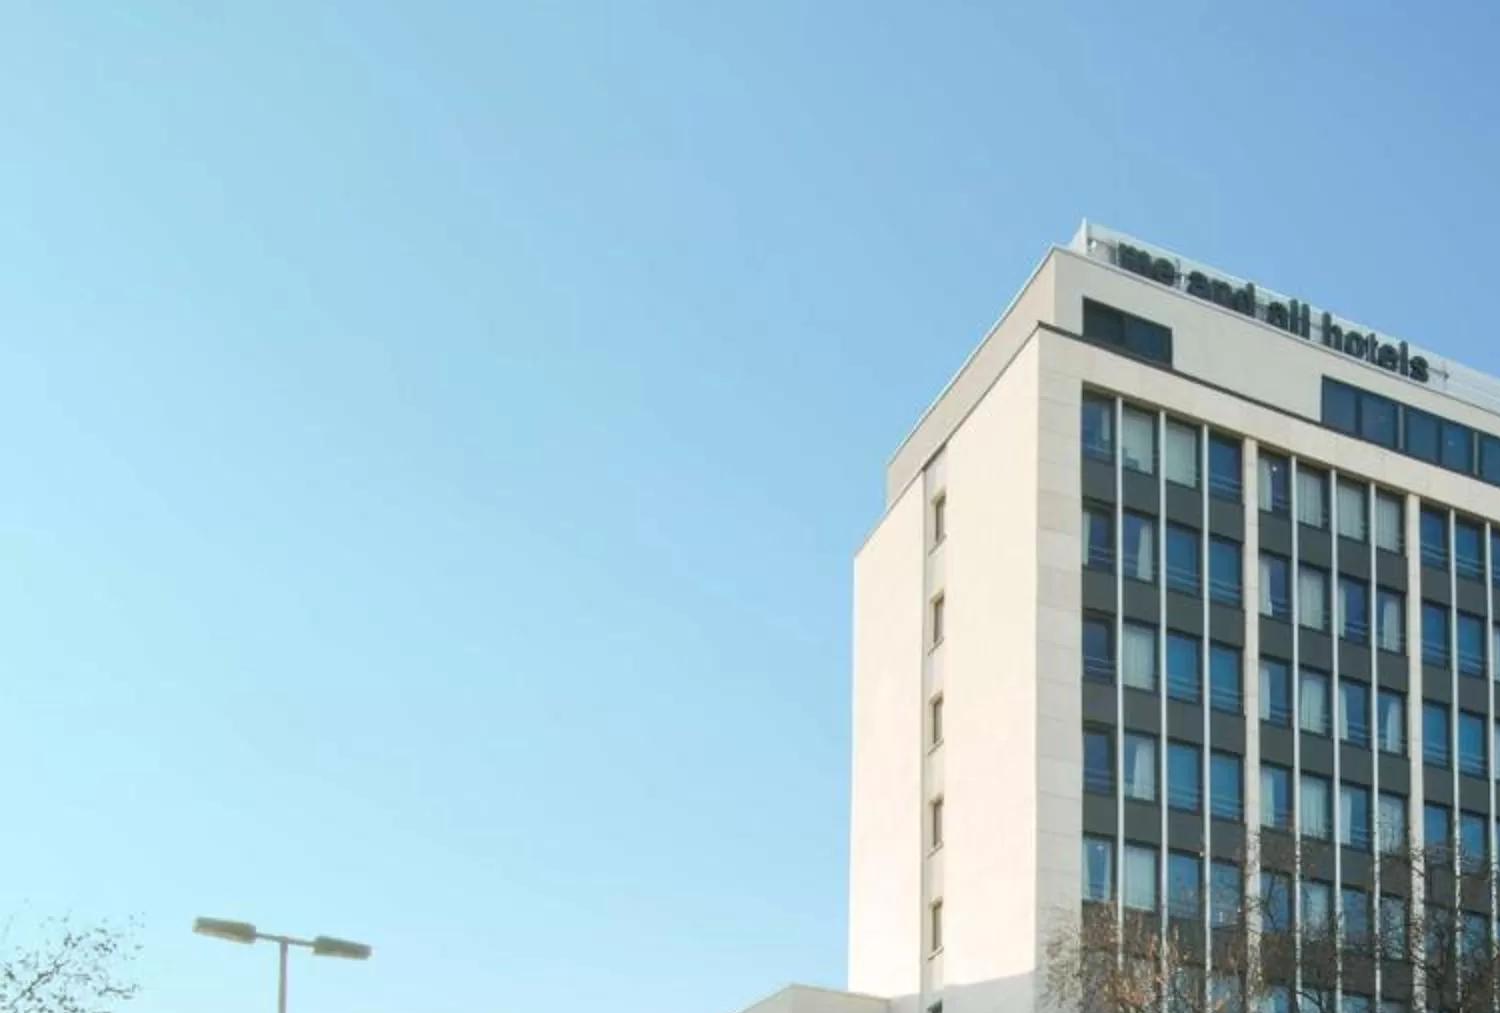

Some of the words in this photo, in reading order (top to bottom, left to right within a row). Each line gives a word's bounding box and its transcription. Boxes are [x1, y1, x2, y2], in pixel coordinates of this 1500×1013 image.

[1118, 241, 1175, 287] me
[1186, 270, 1255, 316] and
[1267, 298, 1311, 340] all
[1322, 310, 1430, 383] hotels
